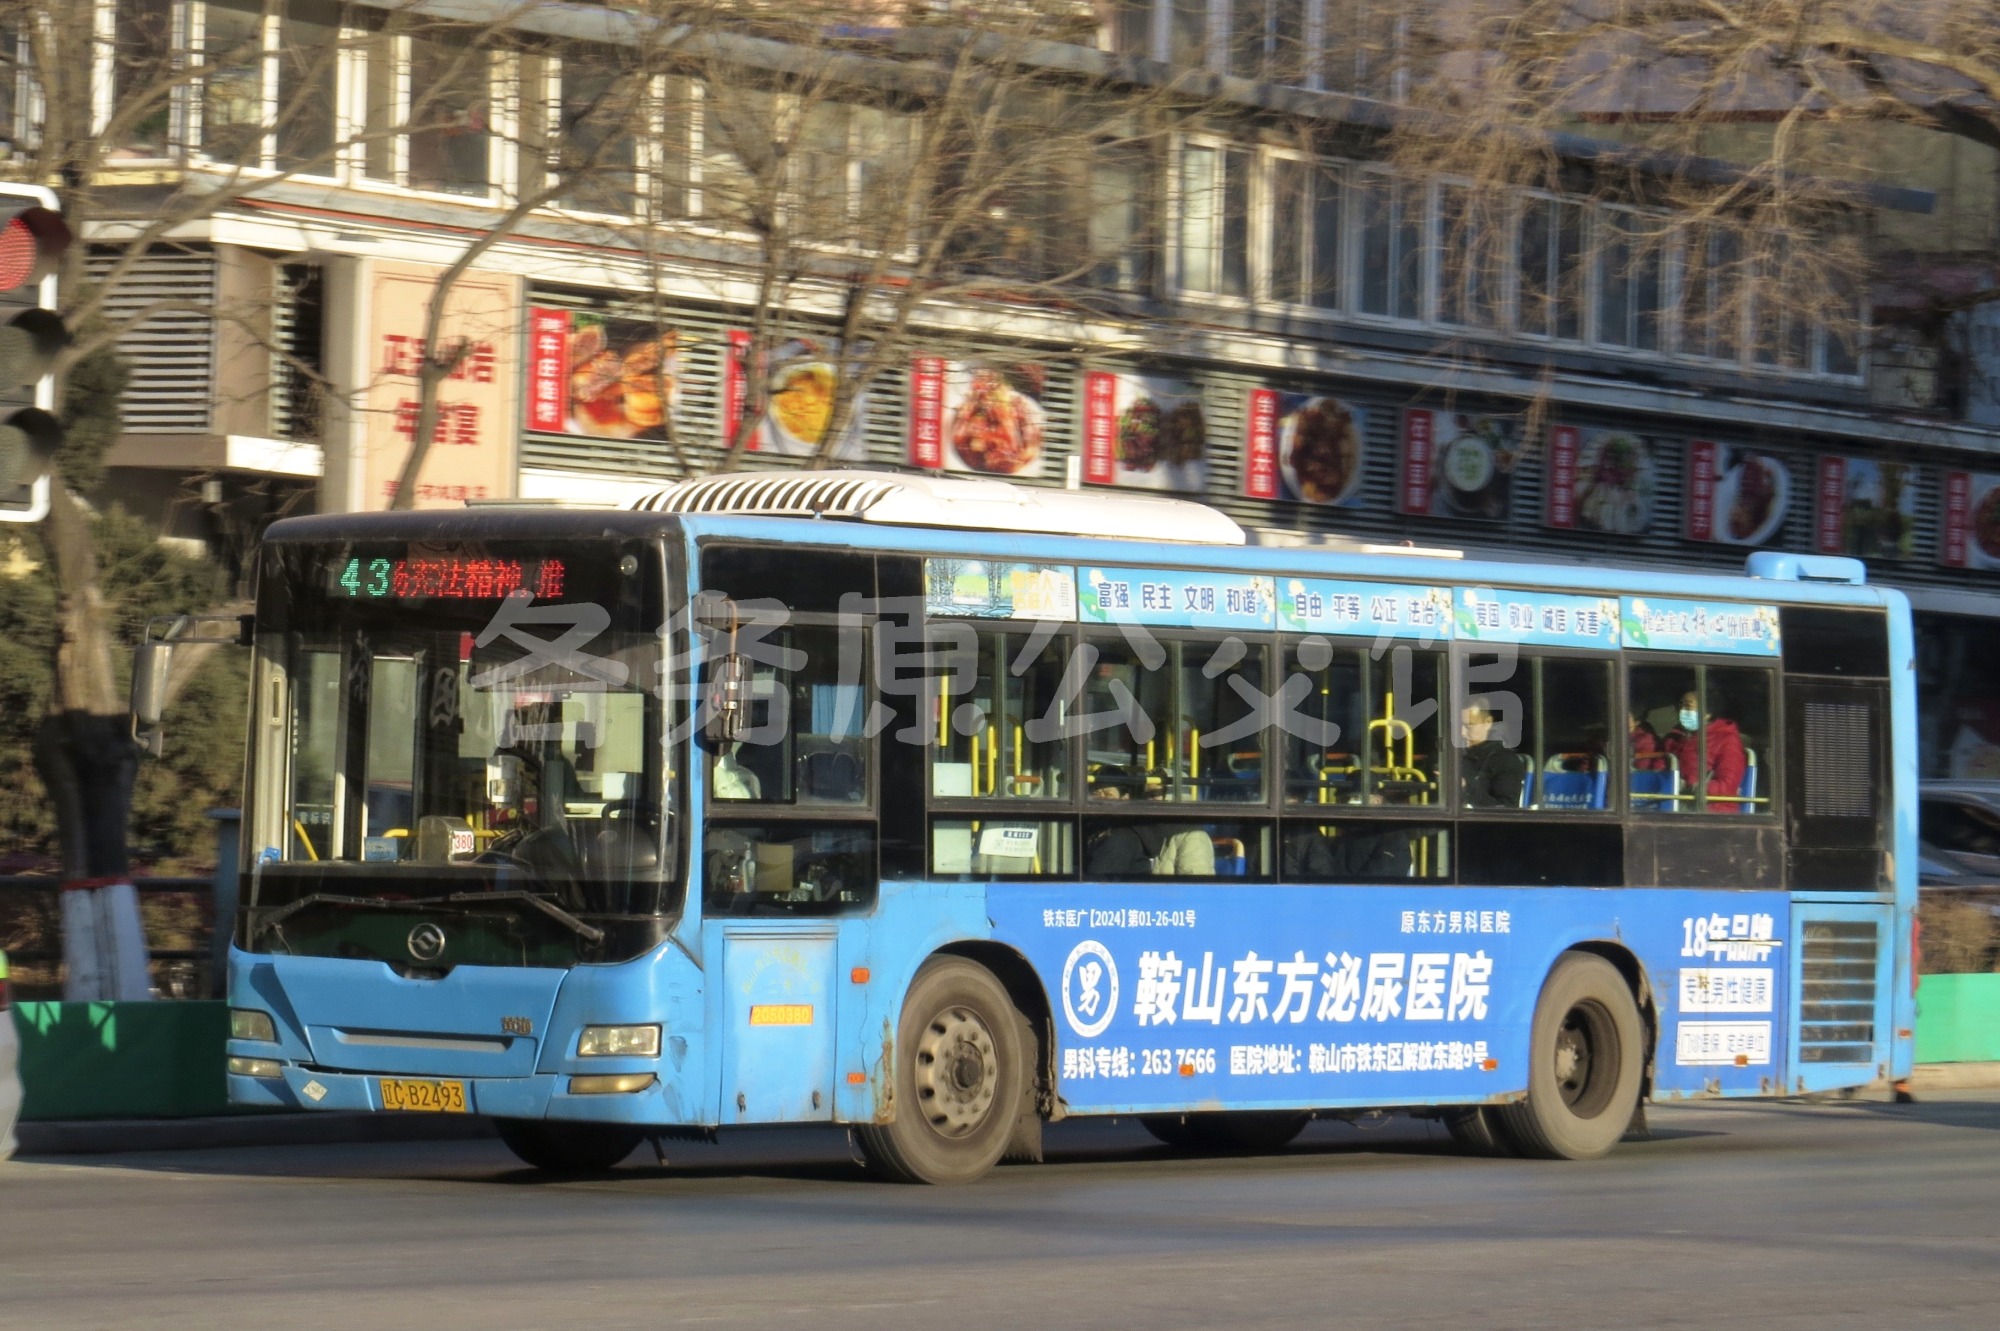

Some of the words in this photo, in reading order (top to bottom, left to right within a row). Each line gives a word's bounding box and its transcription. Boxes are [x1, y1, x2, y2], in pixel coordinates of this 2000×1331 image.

[340, 558, 391, 597] 43
[1098, 581, 1130, 610] 富强
[1141, 583, 1173, 611] 民主
[1184, 586, 1216, 613] 文明
[1227, 587, 1259, 615] 和谐
[1295, 593, 1322, 619] 自由
[1332, 595, 1361, 621] 平等
[1370, 597, 1397, 624] 公正
[1407, 599, 1436, 626] 法治
[1475, 602, 1500, 628] 爱国
[1508, 604, 1534, 631] 敬业
[1541, 607, 1566, 632] 诚信
[1574, 609, 1599, 635] 友善
[455, 834, 473, 849] 380
[1401, 911, 1511, 933] 原东方男科医院
[1133, 950, 1493, 1026] 鞍山东方泌尿医院
